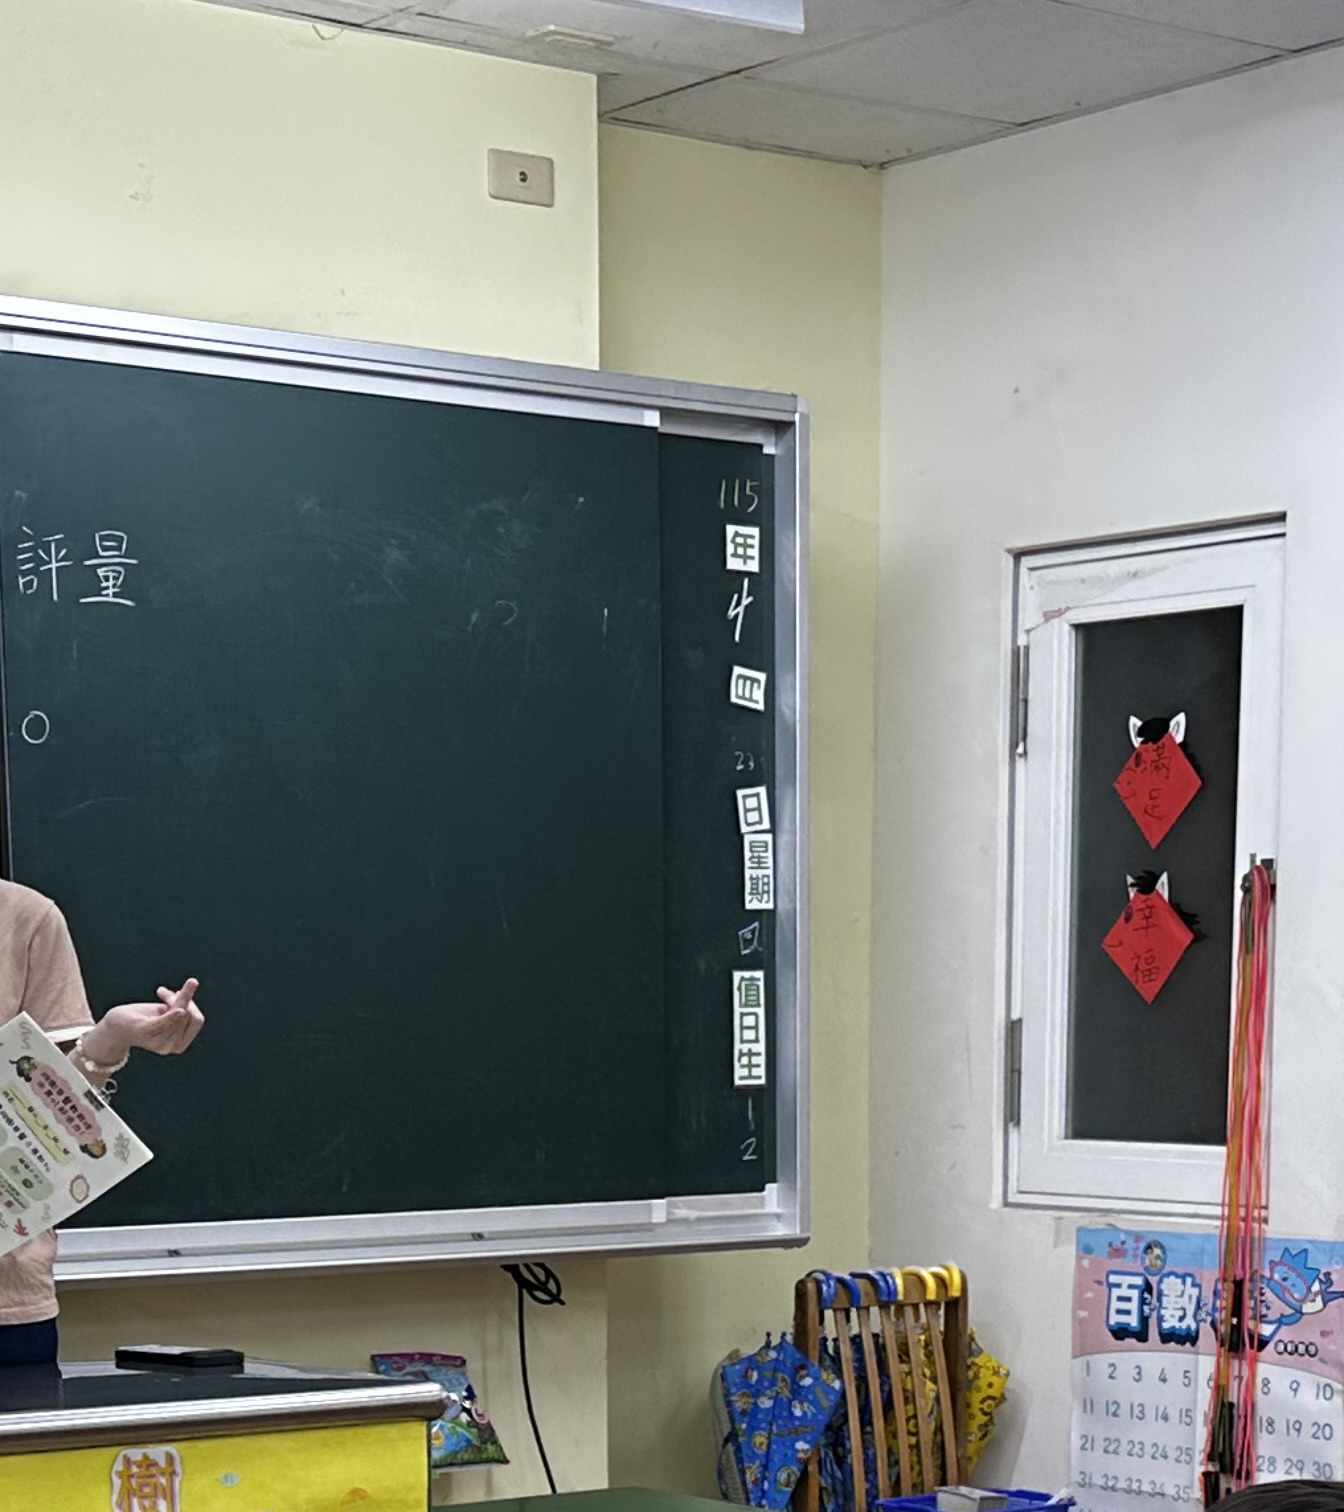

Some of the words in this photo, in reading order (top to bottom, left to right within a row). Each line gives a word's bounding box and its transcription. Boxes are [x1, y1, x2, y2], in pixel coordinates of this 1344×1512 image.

[720, 478, 760, 513] 115
[16, 525, 139, 606] 評量
[730, 529, 756, 566] 年
[727, 577, 754, 643] 4
[741, 791, 765, 828] 日
[747, 839, 772, 905] 星期
[1131, 898, 1159, 985] 幸福
[736, 975, 763, 1082] 值日生
[741, 1137, 758, 1161] 2
[1108, 1363, 1117, 1380] 2
[1132, 1365, 1142, 1382] 3
[1158, 1367, 1168, 1384] 4
[1182, 1371, 1192, 1387] 5
[1261, 1378, 1271, 1395] 8
[1290, 1380, 1300, 1397] 9
[1315, 1383, 1334, 1401] 10
[1082, 1398, 1094, 1414] 11
[1106, 1400, 1120, 1417] 12
[1129, 1402, 1145, 1420] 13
[1154, 1404, 1169, 1423] 14
[1179, 1408, 1193, 1426] 15
[1258, 1416, 1275, 1434] 18
[1286, 1419, 1302, 1438] 19
[1311, 1422, 1333, 1440] 20
[1080, 1434, 1094, 1452] 21
[1103, 1436, 1120, 1455] 22
[1127, 1439, 1145, 1458] 23
[1151, 1442, 1168, 1460] 24
[1174, 1446, 1192, 1464] 25
[1257, 1455, 1276, 1474] 28
[1284, 1458, 1304, 1476] 29
[1312, 1462, 1333, 1480] 30
[1078, 1471, 1093, 1489] 31
[1100, 1473, 1118, 1493] 32
[1124, 1475, 1143, 1496] 33
[1148, 1478, 1166, 1499] 34
[1173, 1484, 1191, 1503] 35
